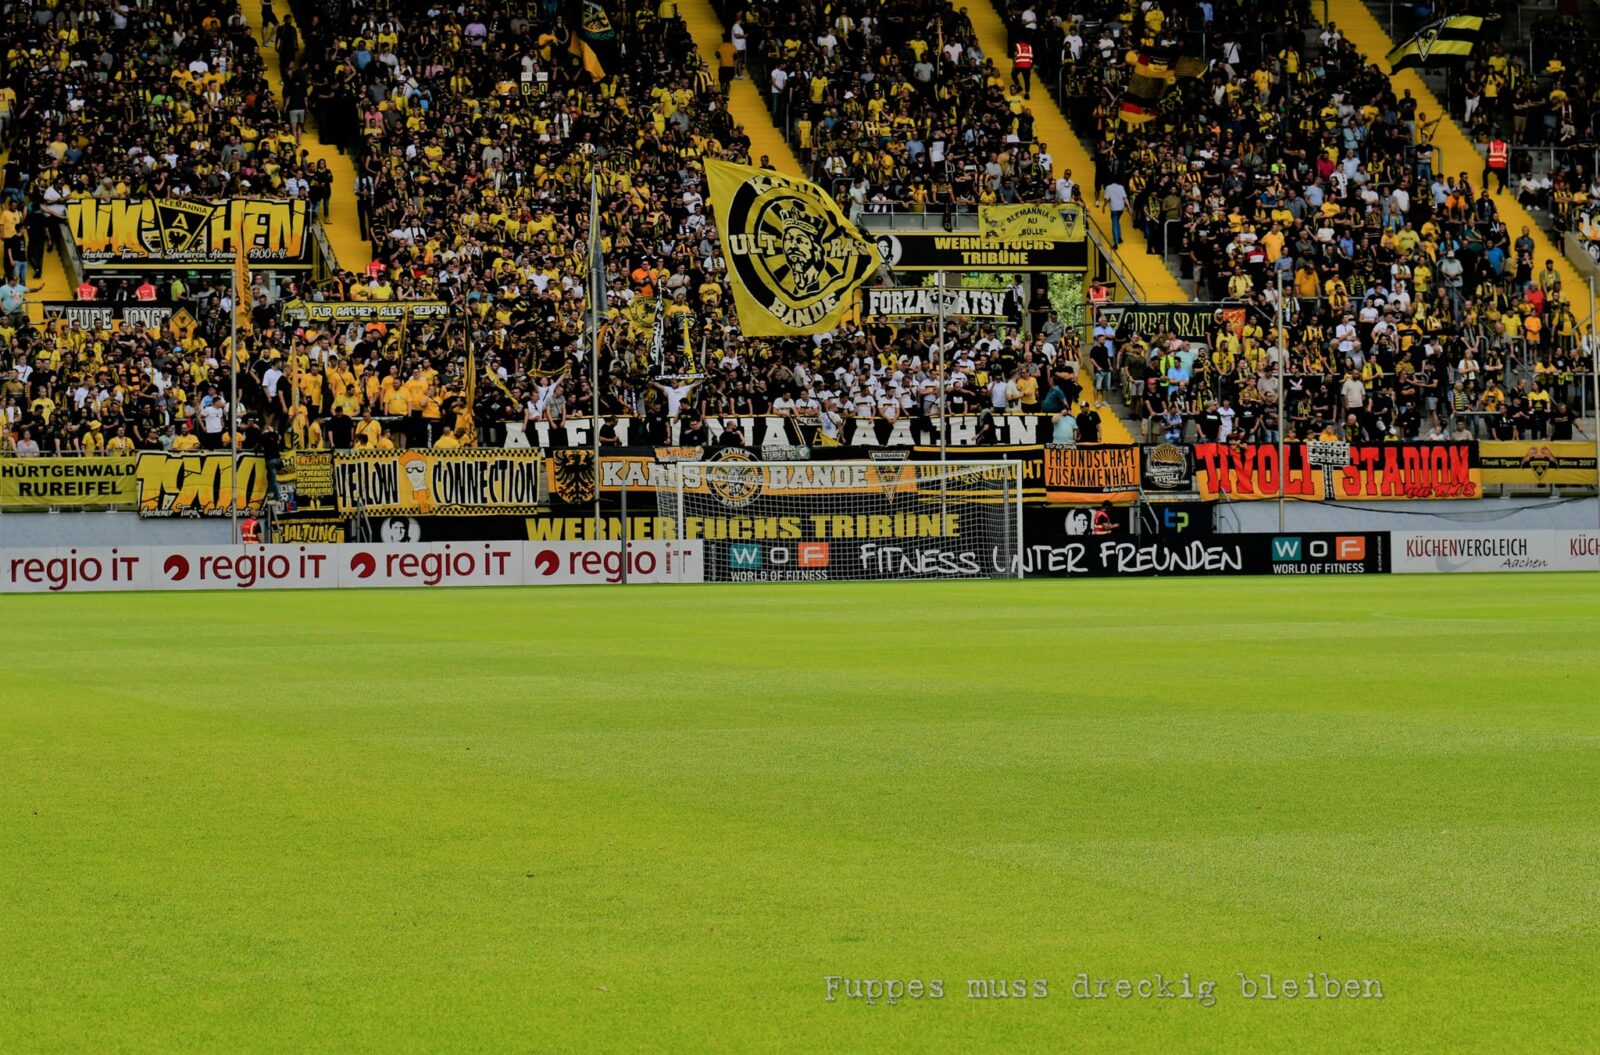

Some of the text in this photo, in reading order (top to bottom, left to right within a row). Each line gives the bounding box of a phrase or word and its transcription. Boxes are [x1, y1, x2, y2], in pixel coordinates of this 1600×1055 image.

[158, 199, 208, 215] ALEMANNIA
[934, 236, 1000, 250] WERNER
[961, 250, 1029, 265] TRIBÜNE
[768, 292, 837, 328] BANDE
[869, 290, 1006, 315] FORZA ATSV
[1050, 449, 1135, 468] FREUNDSCHAFT
[1195, 443, 1470, 496] TIVOLI STADION
[2, 463, 136, 477] HÜRTGENWALD
[1048, 467, 1136, 486] ZUSAMMENHALT
[18, 481, 122, 497] RUREIFEL
[336, 460, 399, 508] YELLOW
[432, 459, 539, 504] CONNECTION
[525, 511, 960, 542] WERNER FUCHS TRIBÜNE
[860, 543, 981, 574] FITNESS
[1099, 540, 1242, 572] FREUNDEN
[1406, 535, 1527, 557] KÜCHENVERGLEICH
[11, 548, 103, 591] regio
[200, 546, 290, 588] regio
[386, 544, 475, 585] regio
[569, 542, 656, 583] regio
[1273, 562, 1364, 574] WORLD OF FITNESS
[1500, 557, 1549, 569] Aachen
[731, 570, 828, 582] WORLD OF FITNESS
